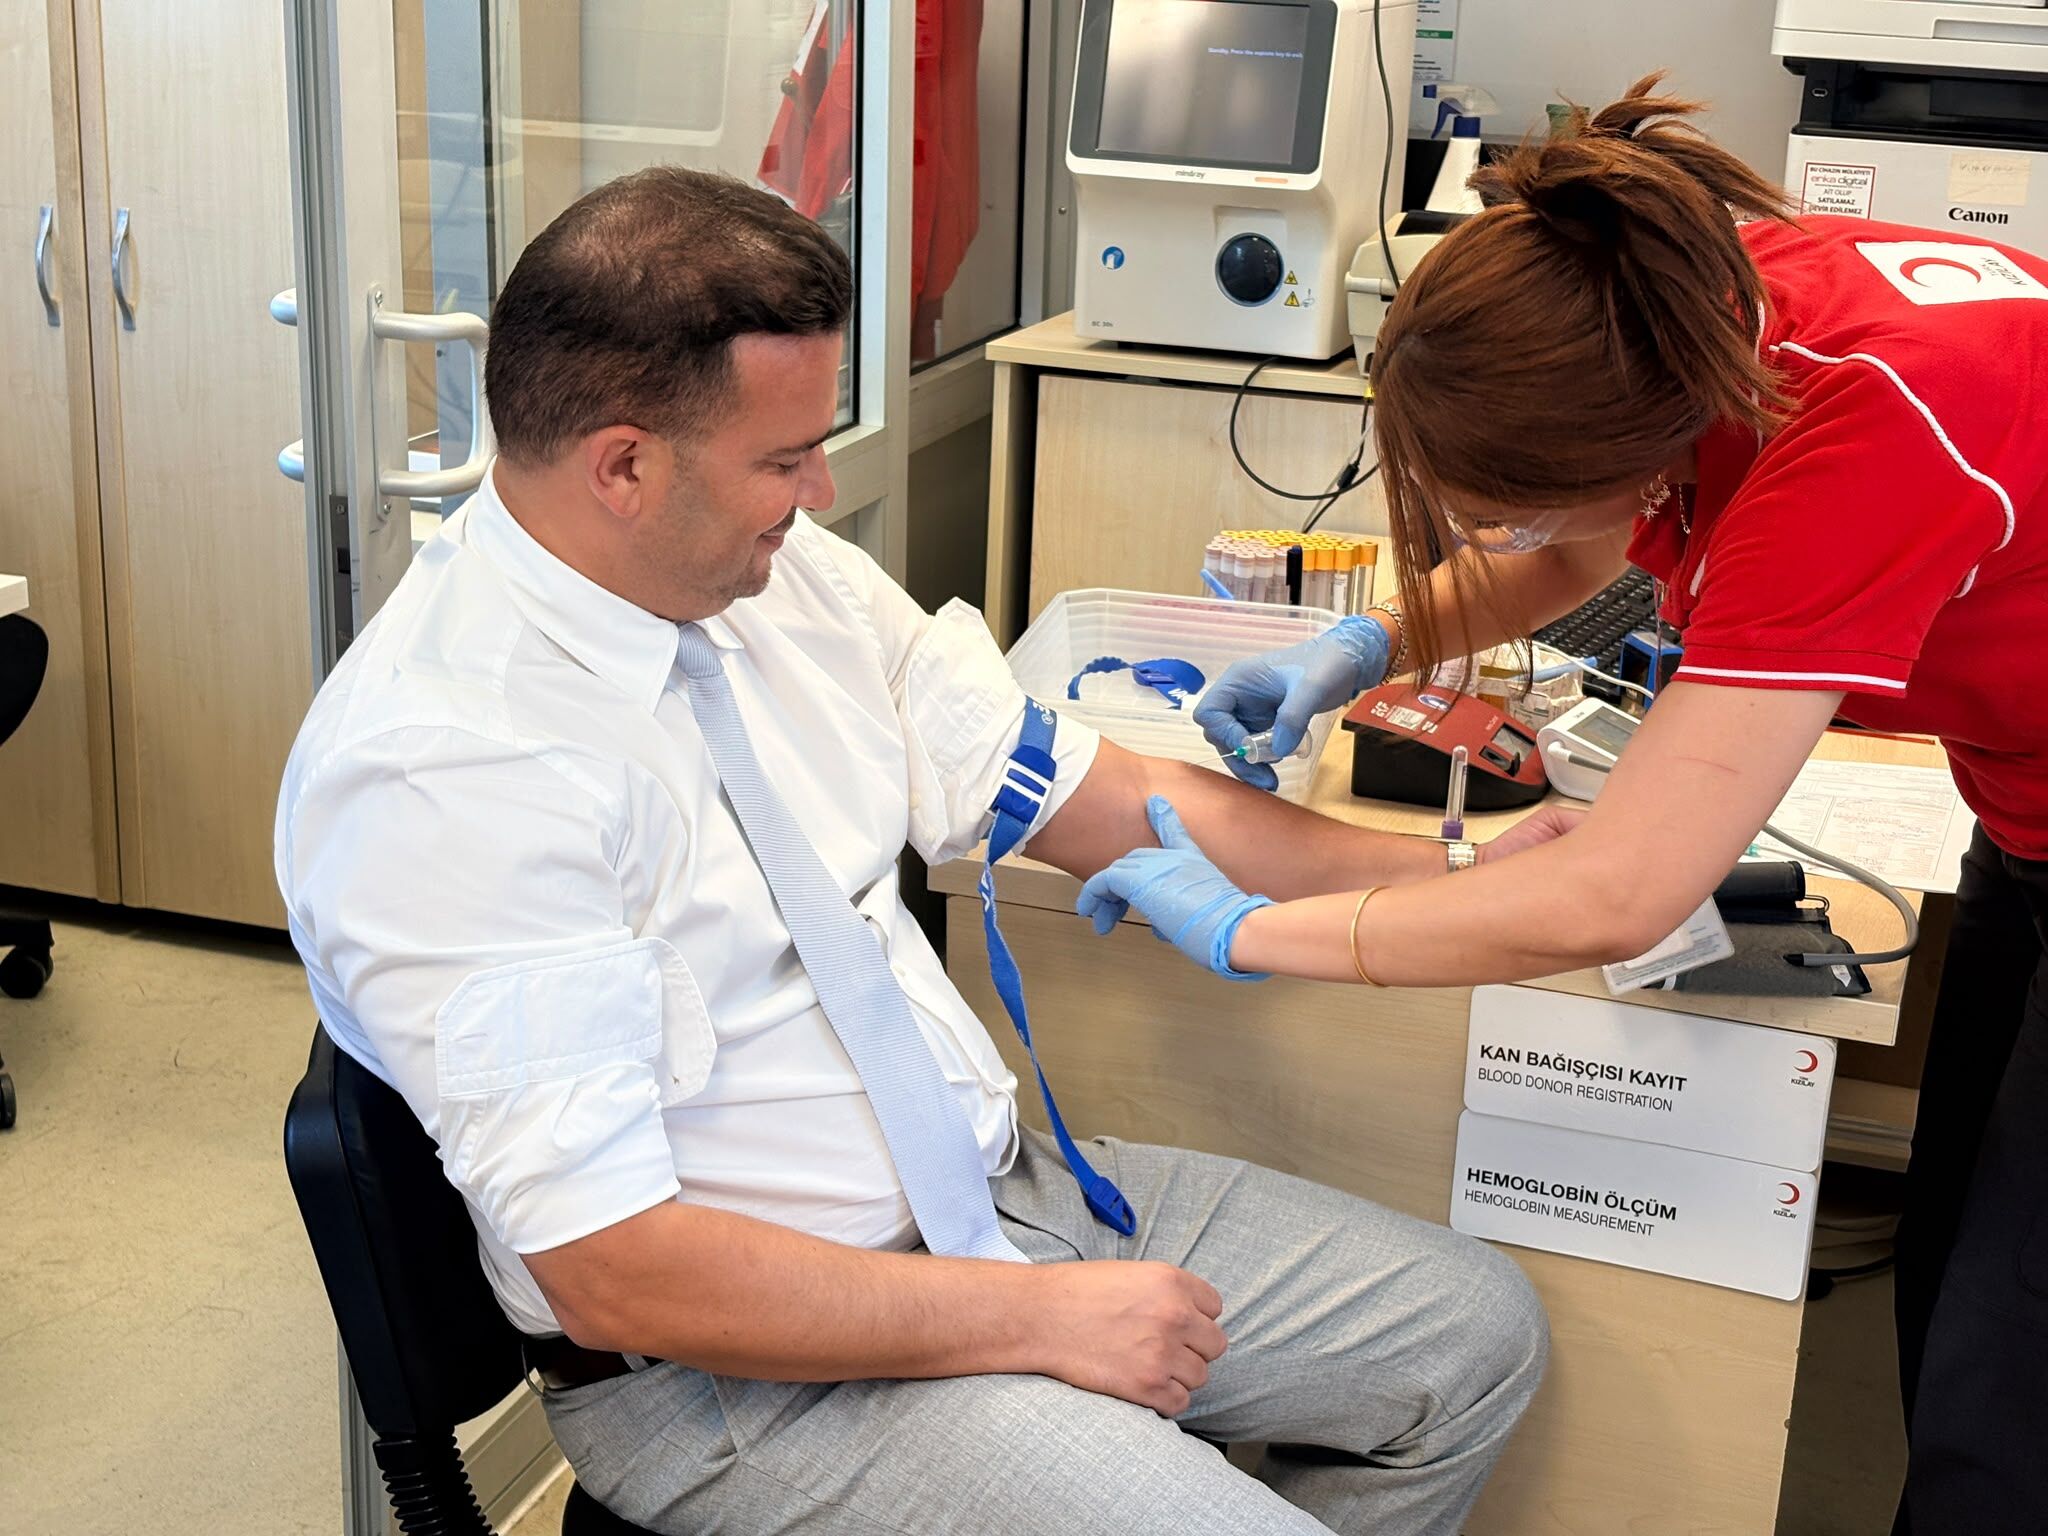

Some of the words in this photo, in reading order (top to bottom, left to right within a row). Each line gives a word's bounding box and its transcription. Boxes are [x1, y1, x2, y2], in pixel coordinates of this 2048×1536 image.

[1837, 176, 1868, 186] digital
[1948, 207, 2009, 225] Canon
[1478, 1067, 1522, 1085] BLOOD
[1525, 1074, 1573, 1096] DONOR
[1576, 1084, 1673, 1112] REGISTRATION
[1480, 1044, 1521, 1064] KAN
[1526, 1051, 1623, 1081] BAĞIŞÇISI
[1629, 1068, 1688, 1092] KAYIT
[1464, 1188, 1551, 1216] HEMOGLOBIN
[1553, 1205, 1655, 1236] MEASUREMENT
[1467, 1167, 1599, 1206] HEMOGLOBİN
[1604, 1190, 1677, 1221] ÖLÇÜM
